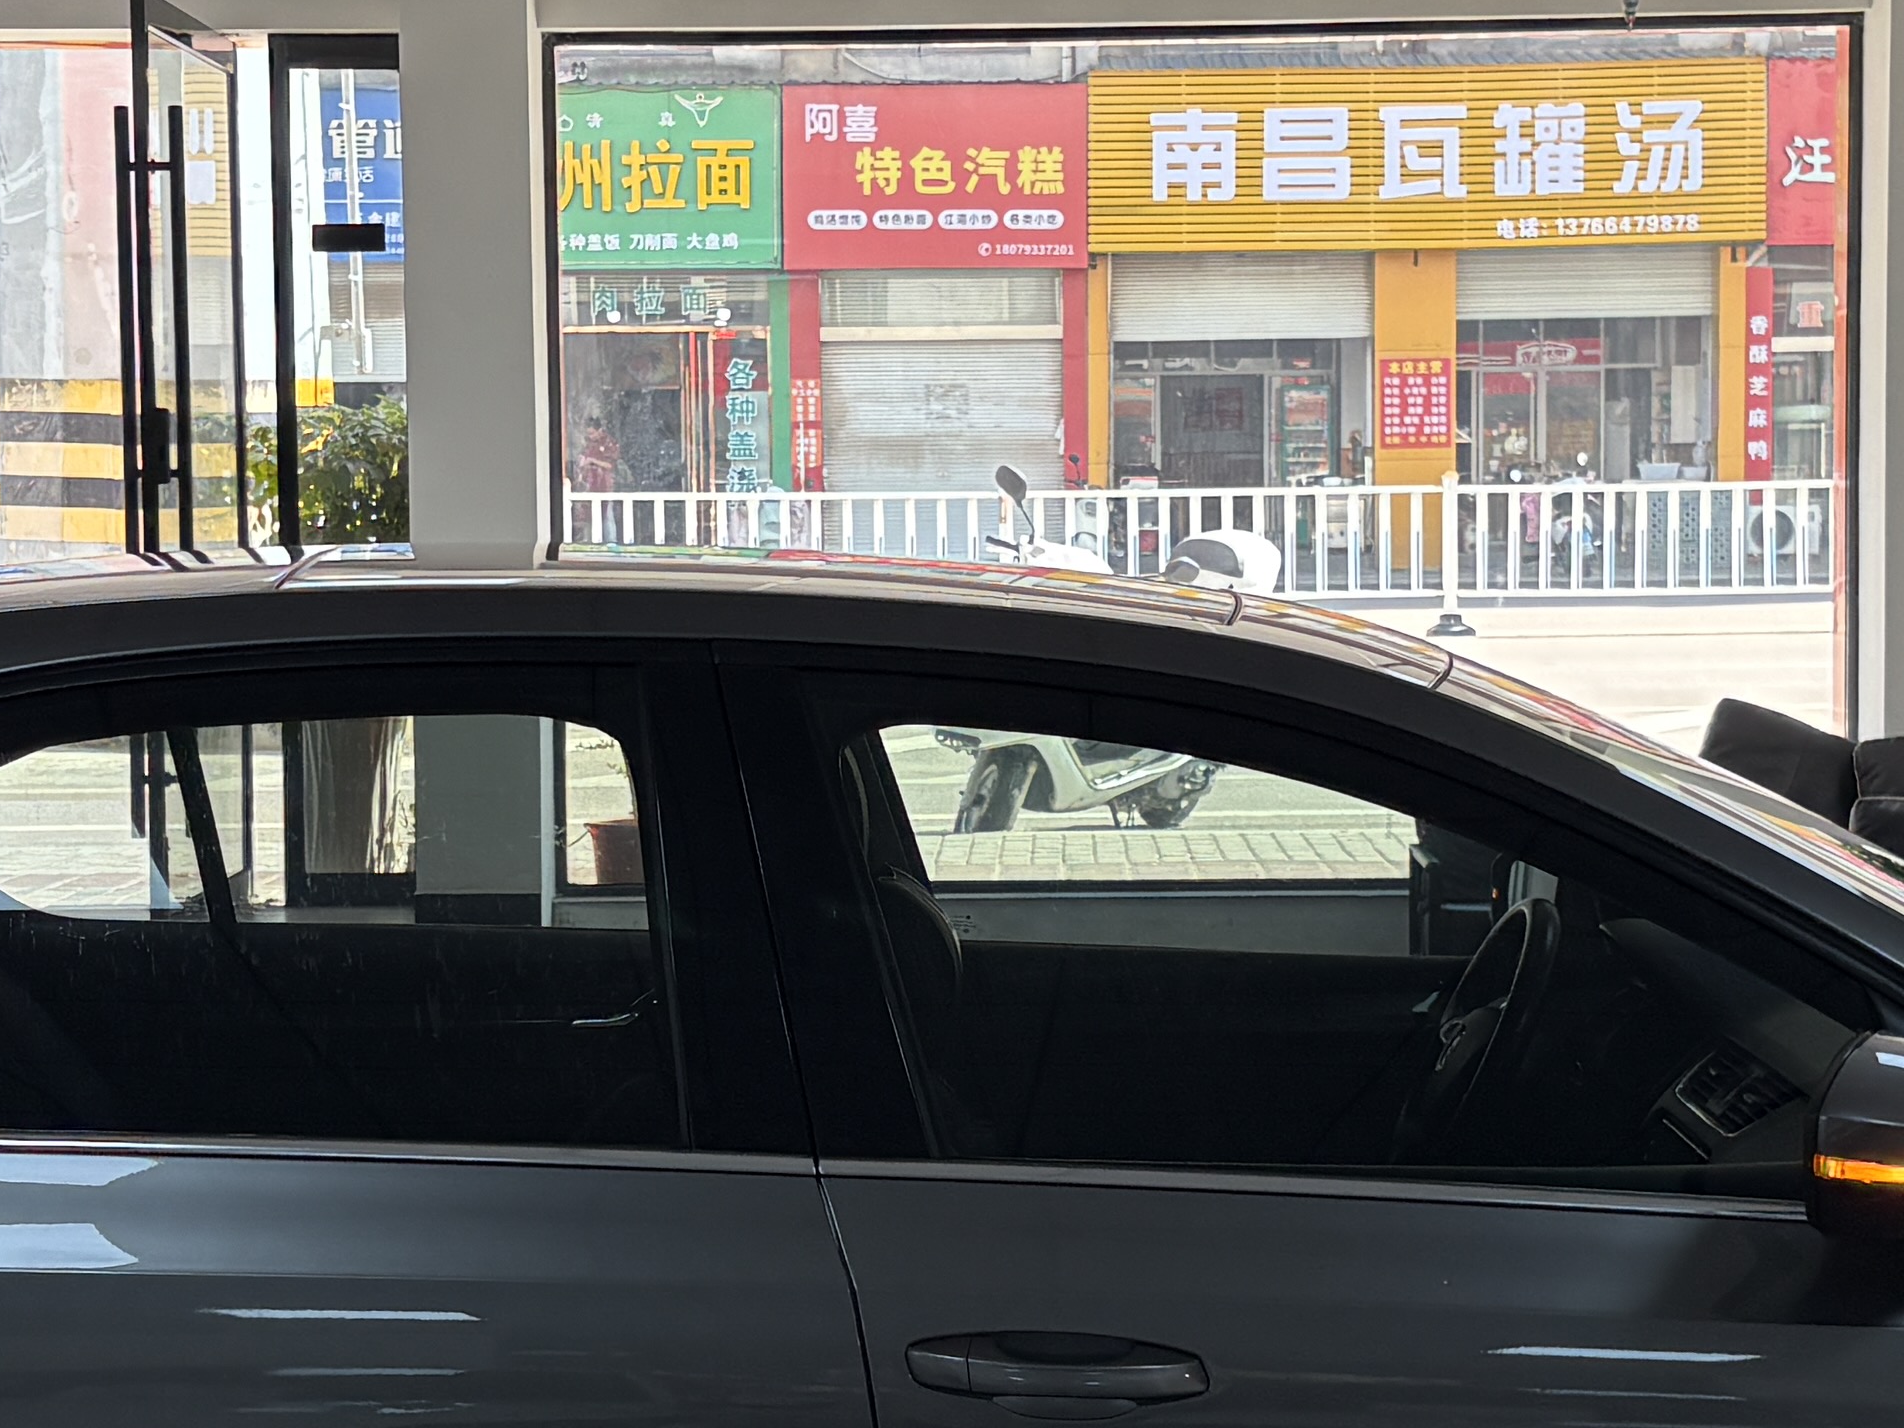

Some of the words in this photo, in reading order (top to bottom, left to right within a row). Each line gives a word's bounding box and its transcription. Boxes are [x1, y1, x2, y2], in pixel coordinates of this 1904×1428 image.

[804, 103, 879, 143] 阿喜
[560, 139, 755, 212] 州拉面
[854, 145, 1065, 196] 特色汽糕
[1150, 100, 1703, 202] 南昌瓦罐汤
[1782, 137, 1835, 187] 汪
